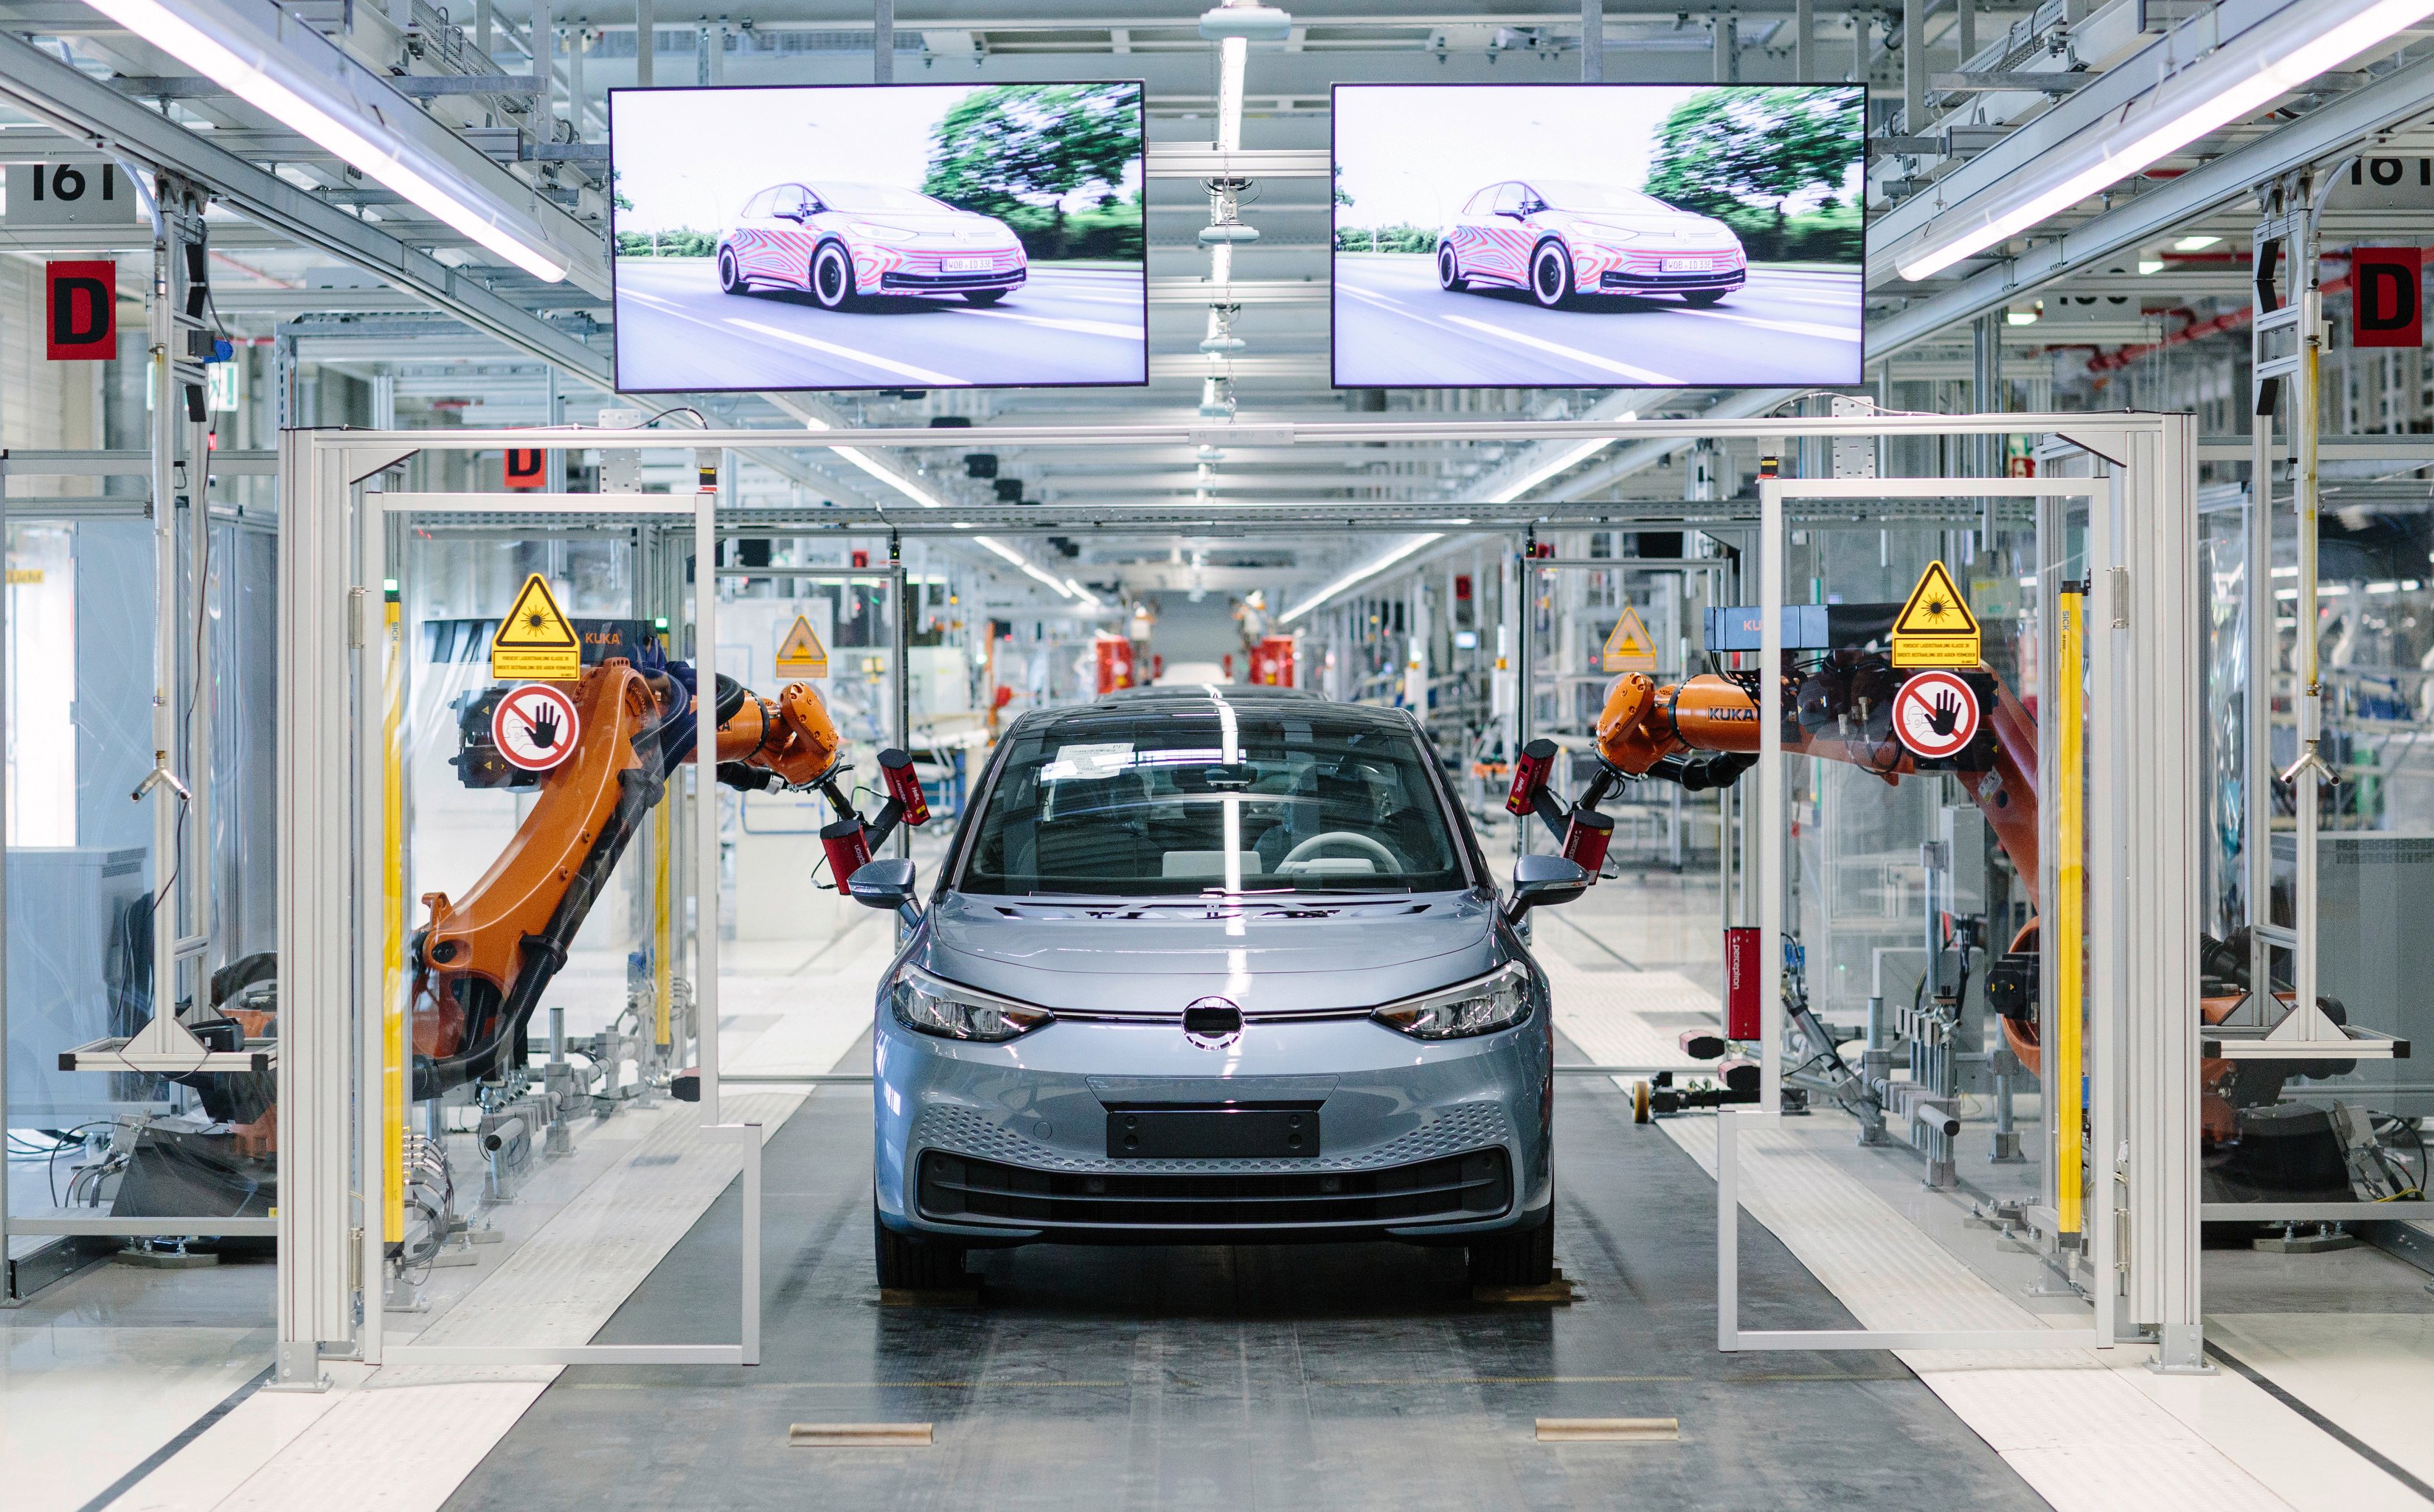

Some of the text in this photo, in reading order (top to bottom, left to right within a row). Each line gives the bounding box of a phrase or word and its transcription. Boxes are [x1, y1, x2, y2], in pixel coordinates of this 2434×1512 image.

[33, 163, 114, 201] 161
[948, 260, 963, 269] WOB
[54, 277, 110, 345] D
[2360, 263, 2416, 330] D
[508, 448, 541, 477] D
[584, 633, 621, 645] KUKA
[1709, 707, 1754, 721] KUKA
[1732, 944, 1741, 990] perceptron
